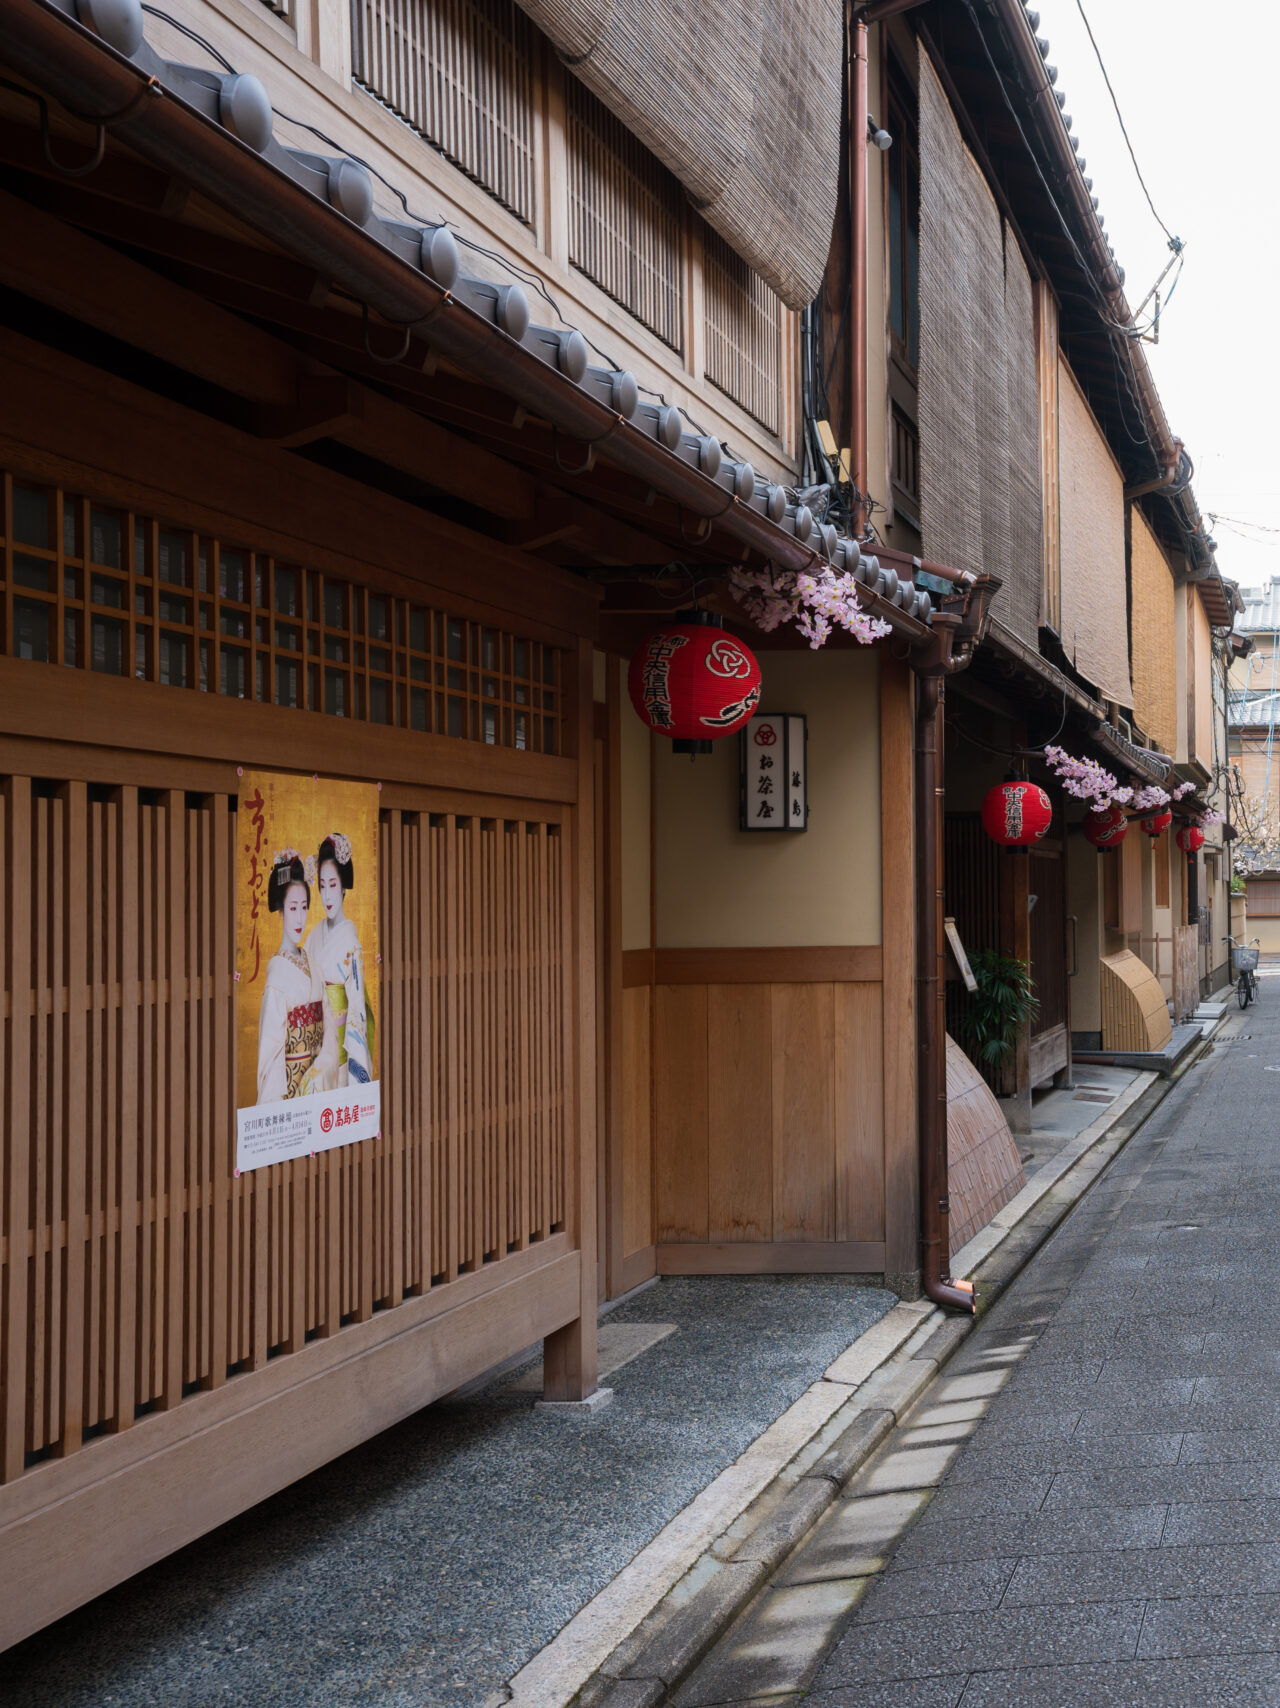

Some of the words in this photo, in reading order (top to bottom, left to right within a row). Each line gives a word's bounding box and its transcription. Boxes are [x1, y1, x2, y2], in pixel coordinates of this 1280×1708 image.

[643, 644, 675, 729] 中央信用金庫
[756, 754, 775, 819] お茶屋
[1005, 791, 1024, 840] 中央信用金庫
[244, 788, 268, 984] 京おどり
